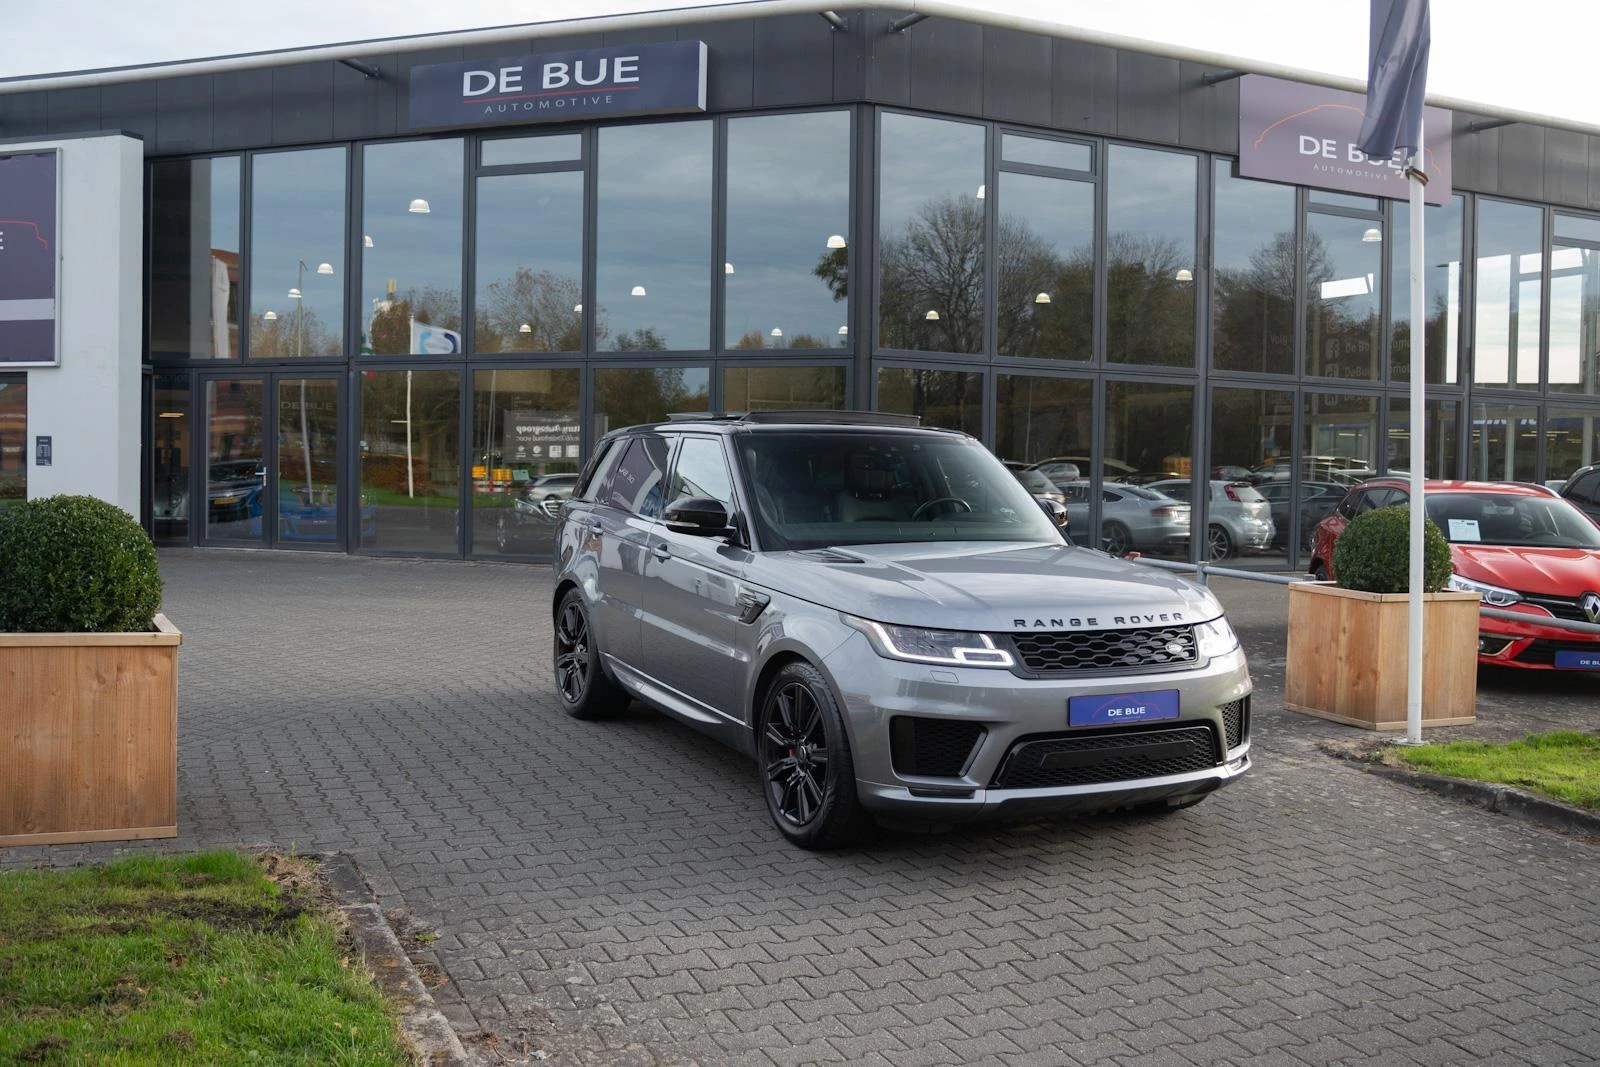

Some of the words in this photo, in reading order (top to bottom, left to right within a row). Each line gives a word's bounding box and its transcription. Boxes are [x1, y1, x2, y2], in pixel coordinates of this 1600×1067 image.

[463, 66, 523, 97] DE
[542, 55, 640, 90] BUE
[484, 95, 613, 115] AUTOMOTIVE
[1299, 135, 1337, 159] DE
[1313, 163, 1388, 181] AUTOMOTIVE
[1013, 618, 1099, 628] RANGE
[1114, 612, 1184, 625] ROVER
[1107, 708, 1123, 717] DE
[1125, 706, 1146, 716] BUE
